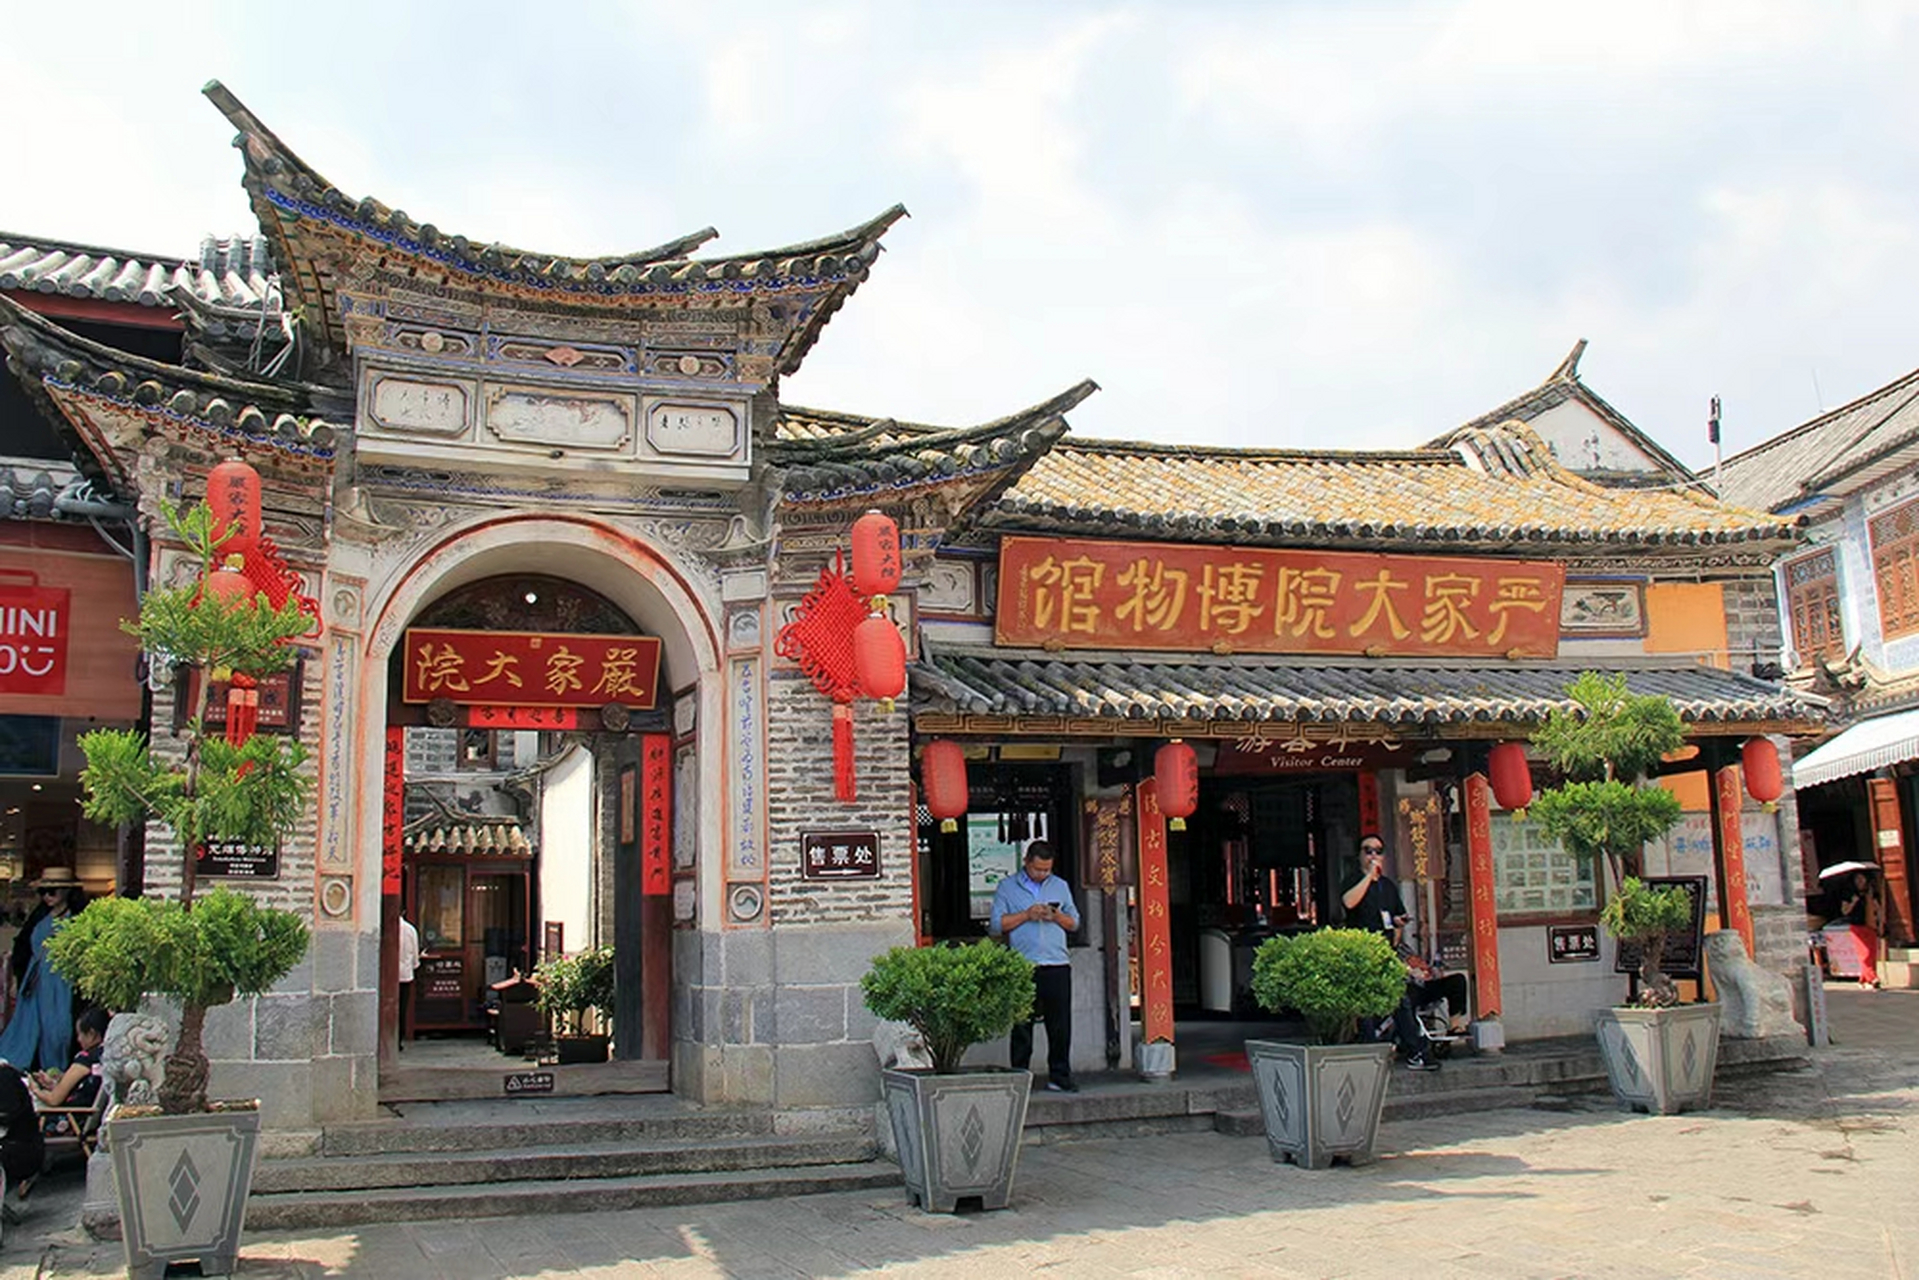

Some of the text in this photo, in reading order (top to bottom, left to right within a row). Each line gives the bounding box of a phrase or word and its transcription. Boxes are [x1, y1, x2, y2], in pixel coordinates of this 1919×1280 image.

[1030, 555, 1547, 645] 严家大院博物馆
[1270, 756, 1363, 768] Visitor Center
